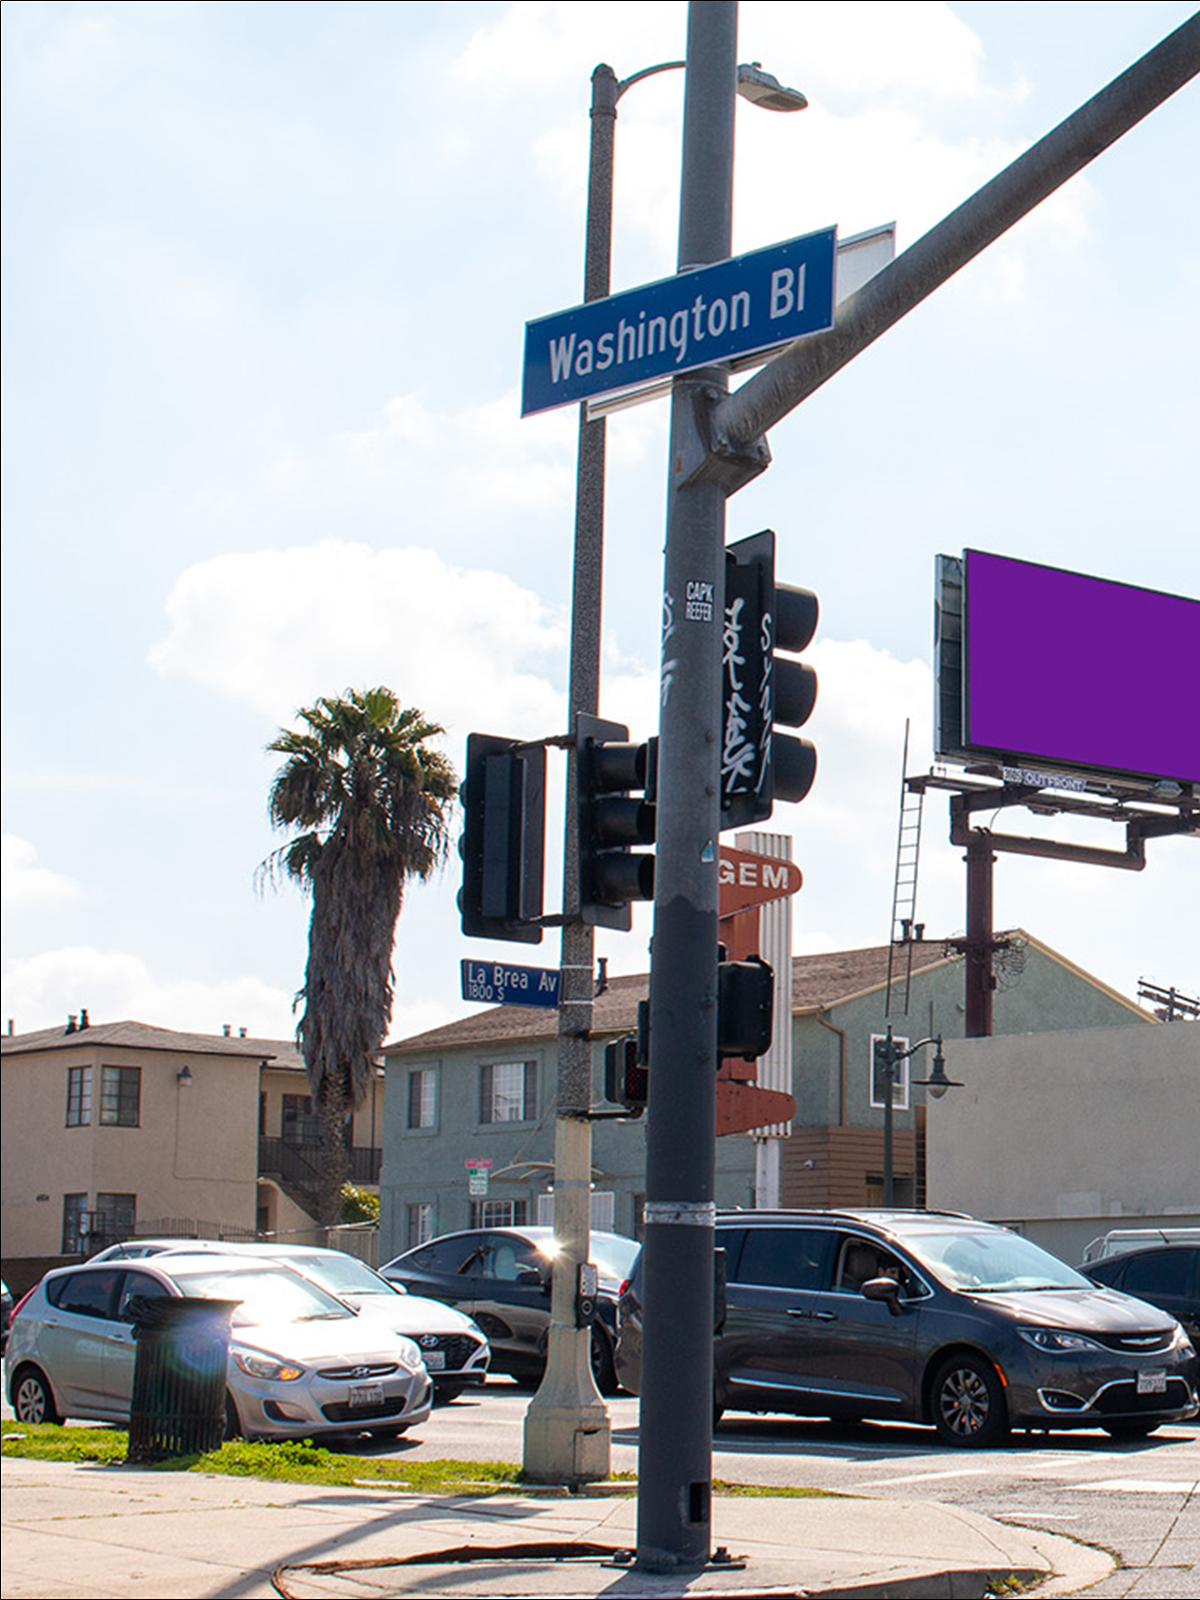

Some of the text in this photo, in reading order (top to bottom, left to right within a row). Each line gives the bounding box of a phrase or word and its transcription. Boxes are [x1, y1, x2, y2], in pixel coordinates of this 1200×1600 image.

[549, 262, 806, 384] Washington Bl
[1025, 771, 1085, 791] OUTFRONT
[719, 859, 789, 890] GEM
[468, 962, 557, 992] La Brea Av
[468, 984, 505, 1001] 1800 S
